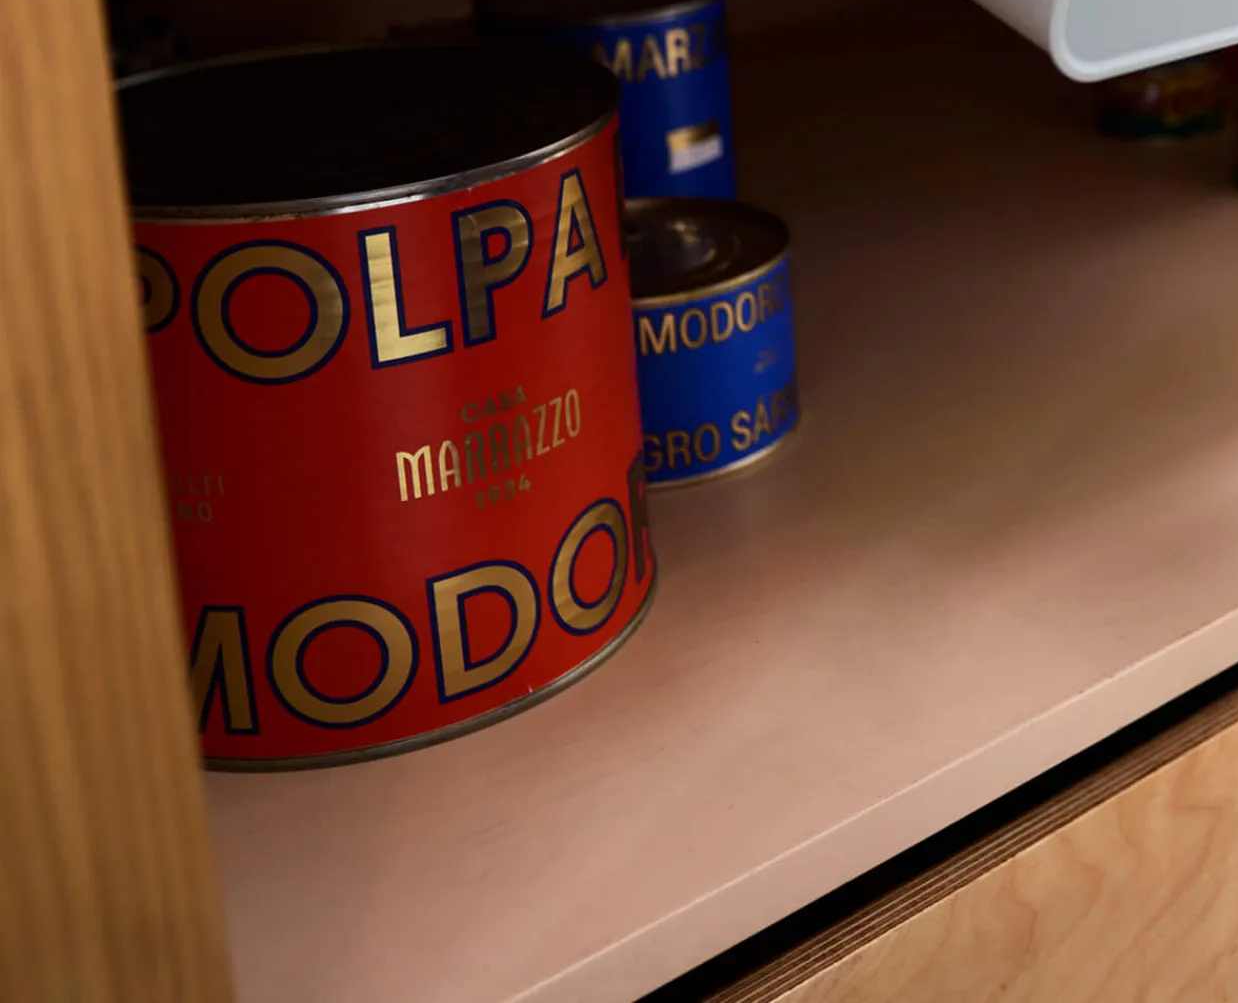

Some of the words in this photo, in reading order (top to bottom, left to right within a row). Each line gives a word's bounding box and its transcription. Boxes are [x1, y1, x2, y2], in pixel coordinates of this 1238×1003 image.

[461, 385, 527, 423] CASA
[396, 388, 581, 502] MARRAZZO
[476, 474, 532, 510] 1934
